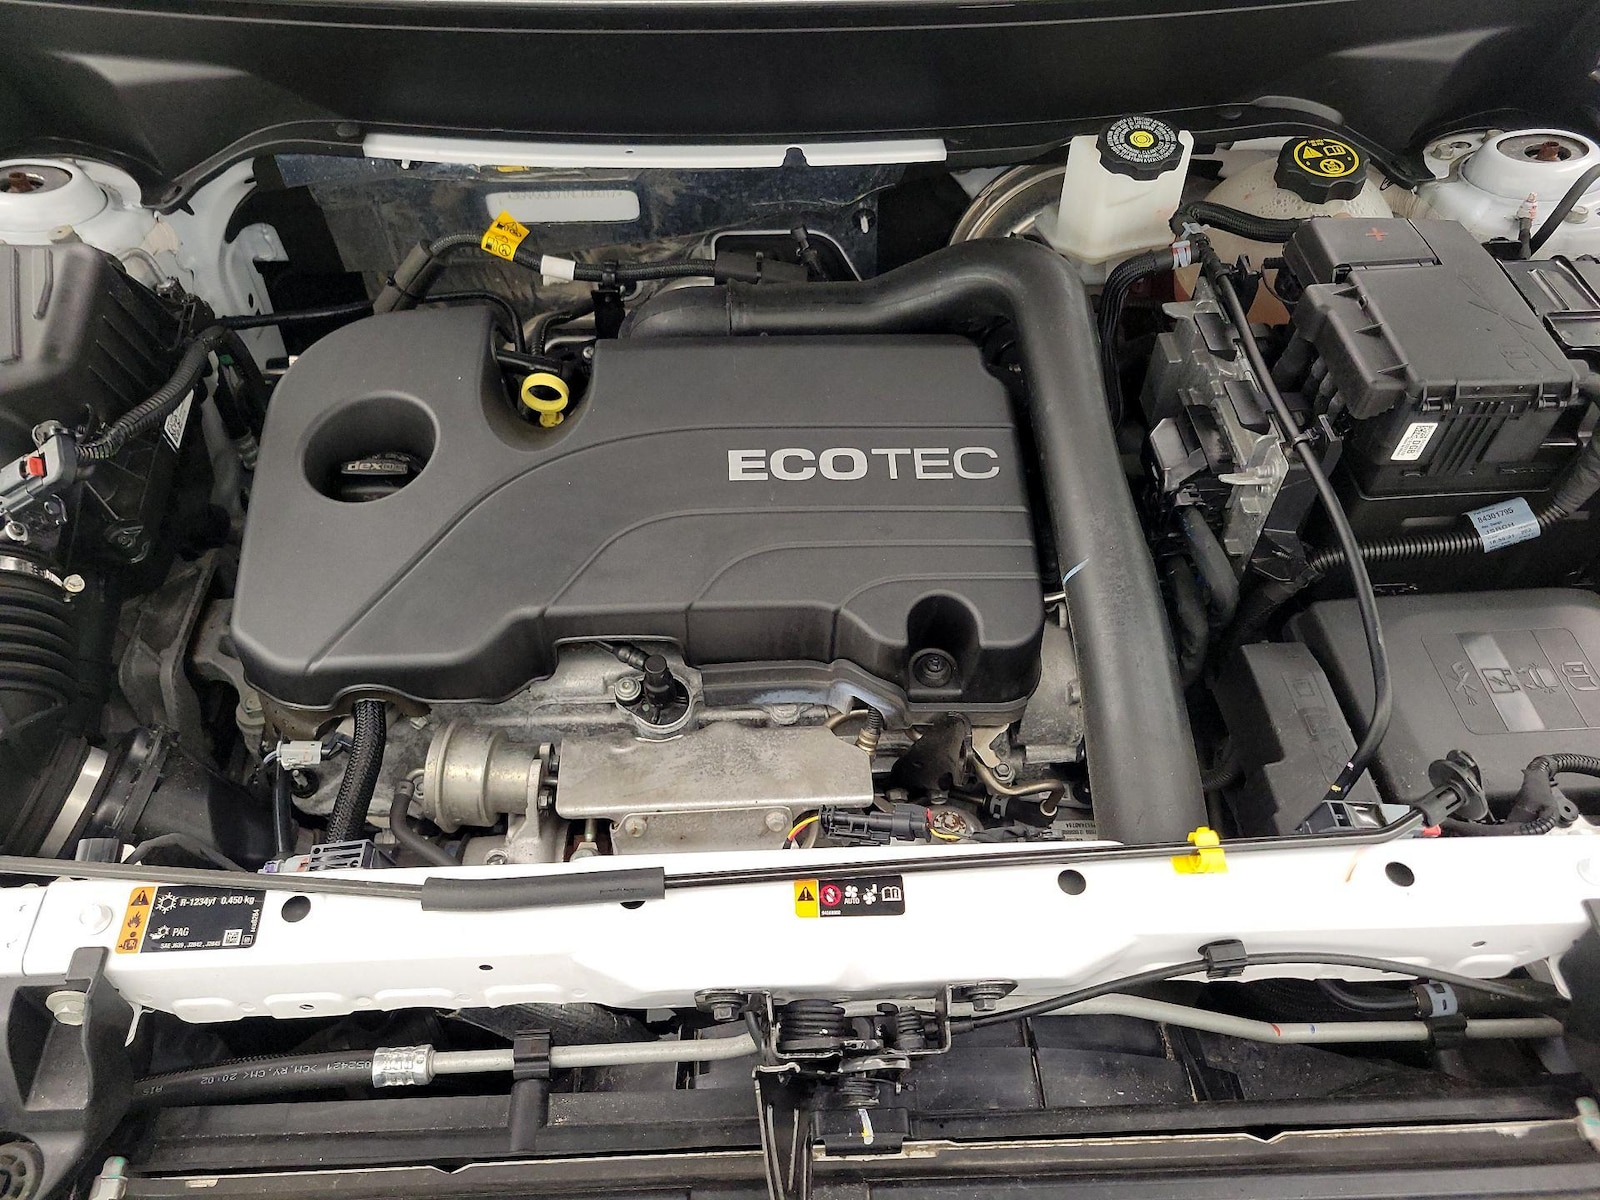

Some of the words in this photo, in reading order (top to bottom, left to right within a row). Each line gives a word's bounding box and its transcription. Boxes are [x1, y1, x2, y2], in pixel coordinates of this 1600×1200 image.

[728, 447, 1000, 481] ECOTEC
[180, 897, 217, 907] R-1234yf
[220, 896, 243, 905] 0.450
[244, 895, 255, 905] kg
[844, 898, 860, 906] AUTO
[172, 927, 190, 937] PAG
[160, 941, 171, 949] SAE
